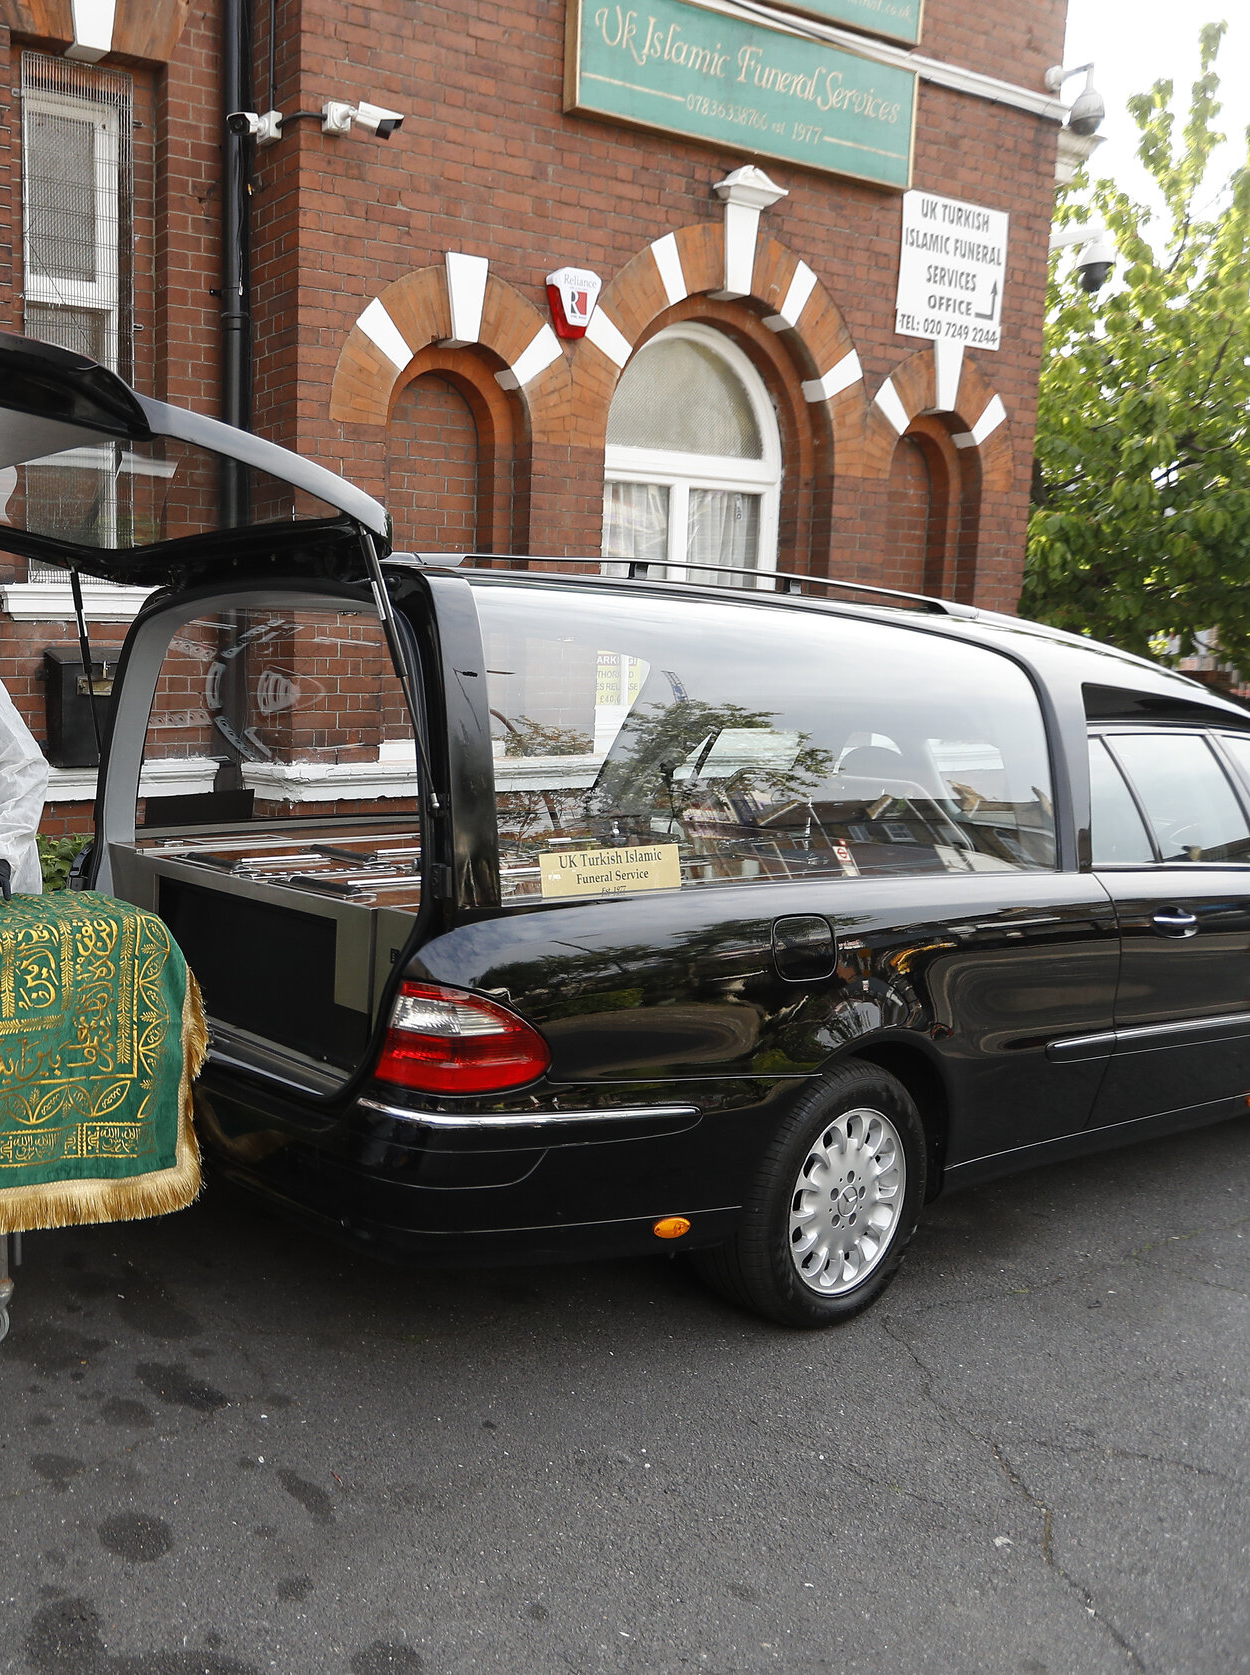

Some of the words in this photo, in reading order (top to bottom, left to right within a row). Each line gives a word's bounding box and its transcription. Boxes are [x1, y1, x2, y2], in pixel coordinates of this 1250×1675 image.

[643, 15, 730, 78] Islamic
[737, 45, 827, 101] Funeral
[817, 71, 901, 124] Services
[791, 122, 823, 145] 1977
[921, 198, 938, 220] UK
[942, 204, 989, 232] TURKISH
[905, 227, 950, 255] ISLAMIC
[954, 238, 1002, 266] FUNERAL
[564, 274, 597, 288] Reliance
[926, 264, 977, 292] SERVICES
[928, 294, 973, 316] OFFICE
[900, 314, 920, 331] TEL:
[923, 319, 942, 335] 020
[944, 322, 969, 340] 7249
[972, 327, 998, 345] 2244
[559, 855, 578, 869] UK
[580, 851, 623, 867] Turkish
[625, 848, 662, 864] Islamic
[576, 871, 613, 885] Funeral
[615, 868, 649, 882] Service
